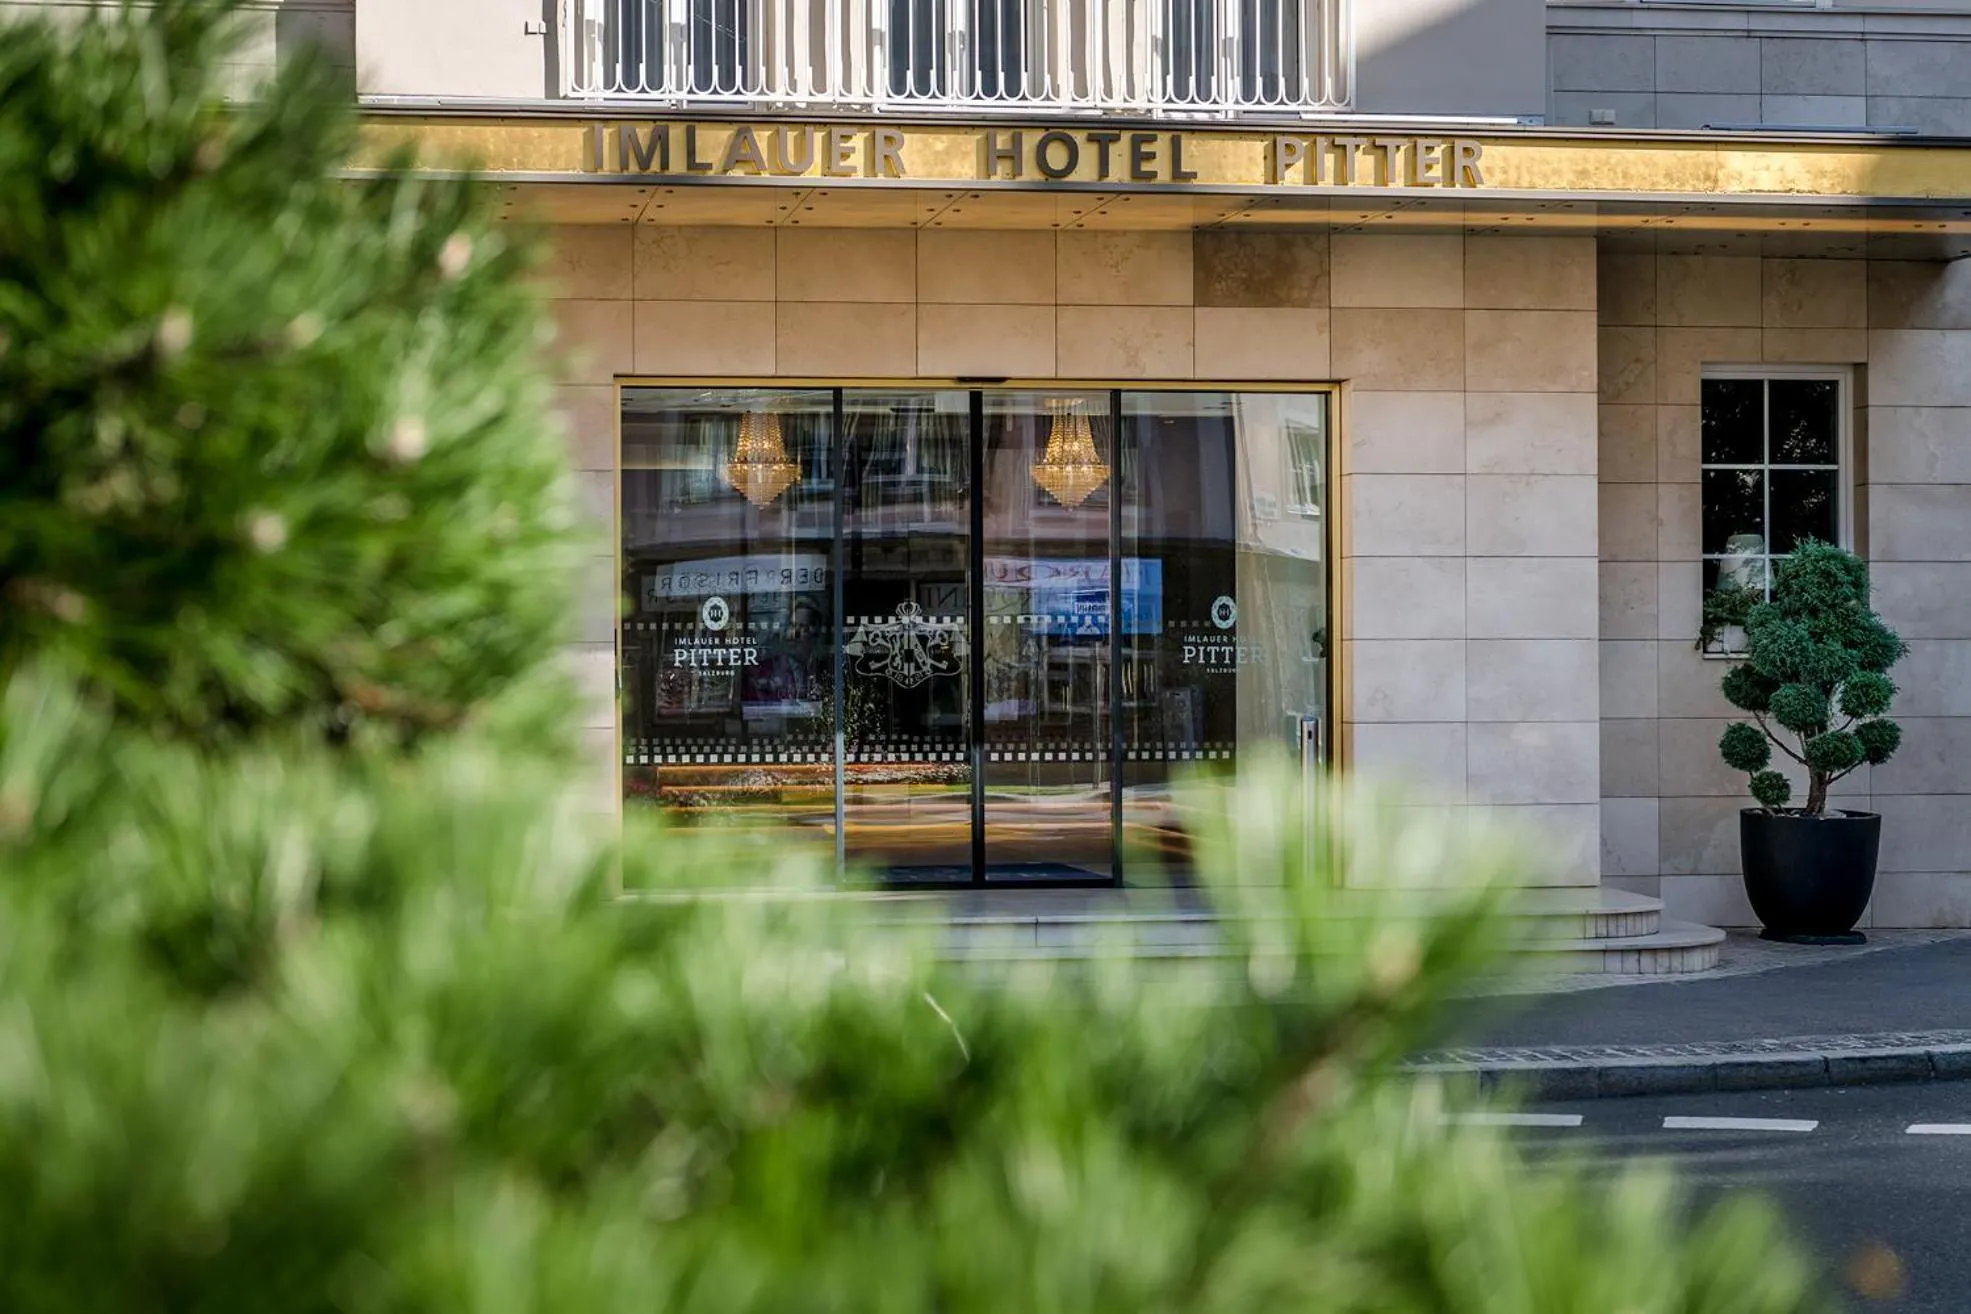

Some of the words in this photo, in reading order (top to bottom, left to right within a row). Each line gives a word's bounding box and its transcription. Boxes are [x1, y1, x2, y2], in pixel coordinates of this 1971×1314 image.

[588, 123, 907, 176] IMLAUER
[984, 128, 1199, 181] HOTEL
[1271, 135, 1486, 188] PITTER
[674, 636, 720, 646] IMLAUER
[724, 636, 758, 646] HOTEL
[1183, 635, 1229, 644] IMLAUER
[673, 647, 760, 668] PITTER
[1182, 645, 1264, 665] PITTER
